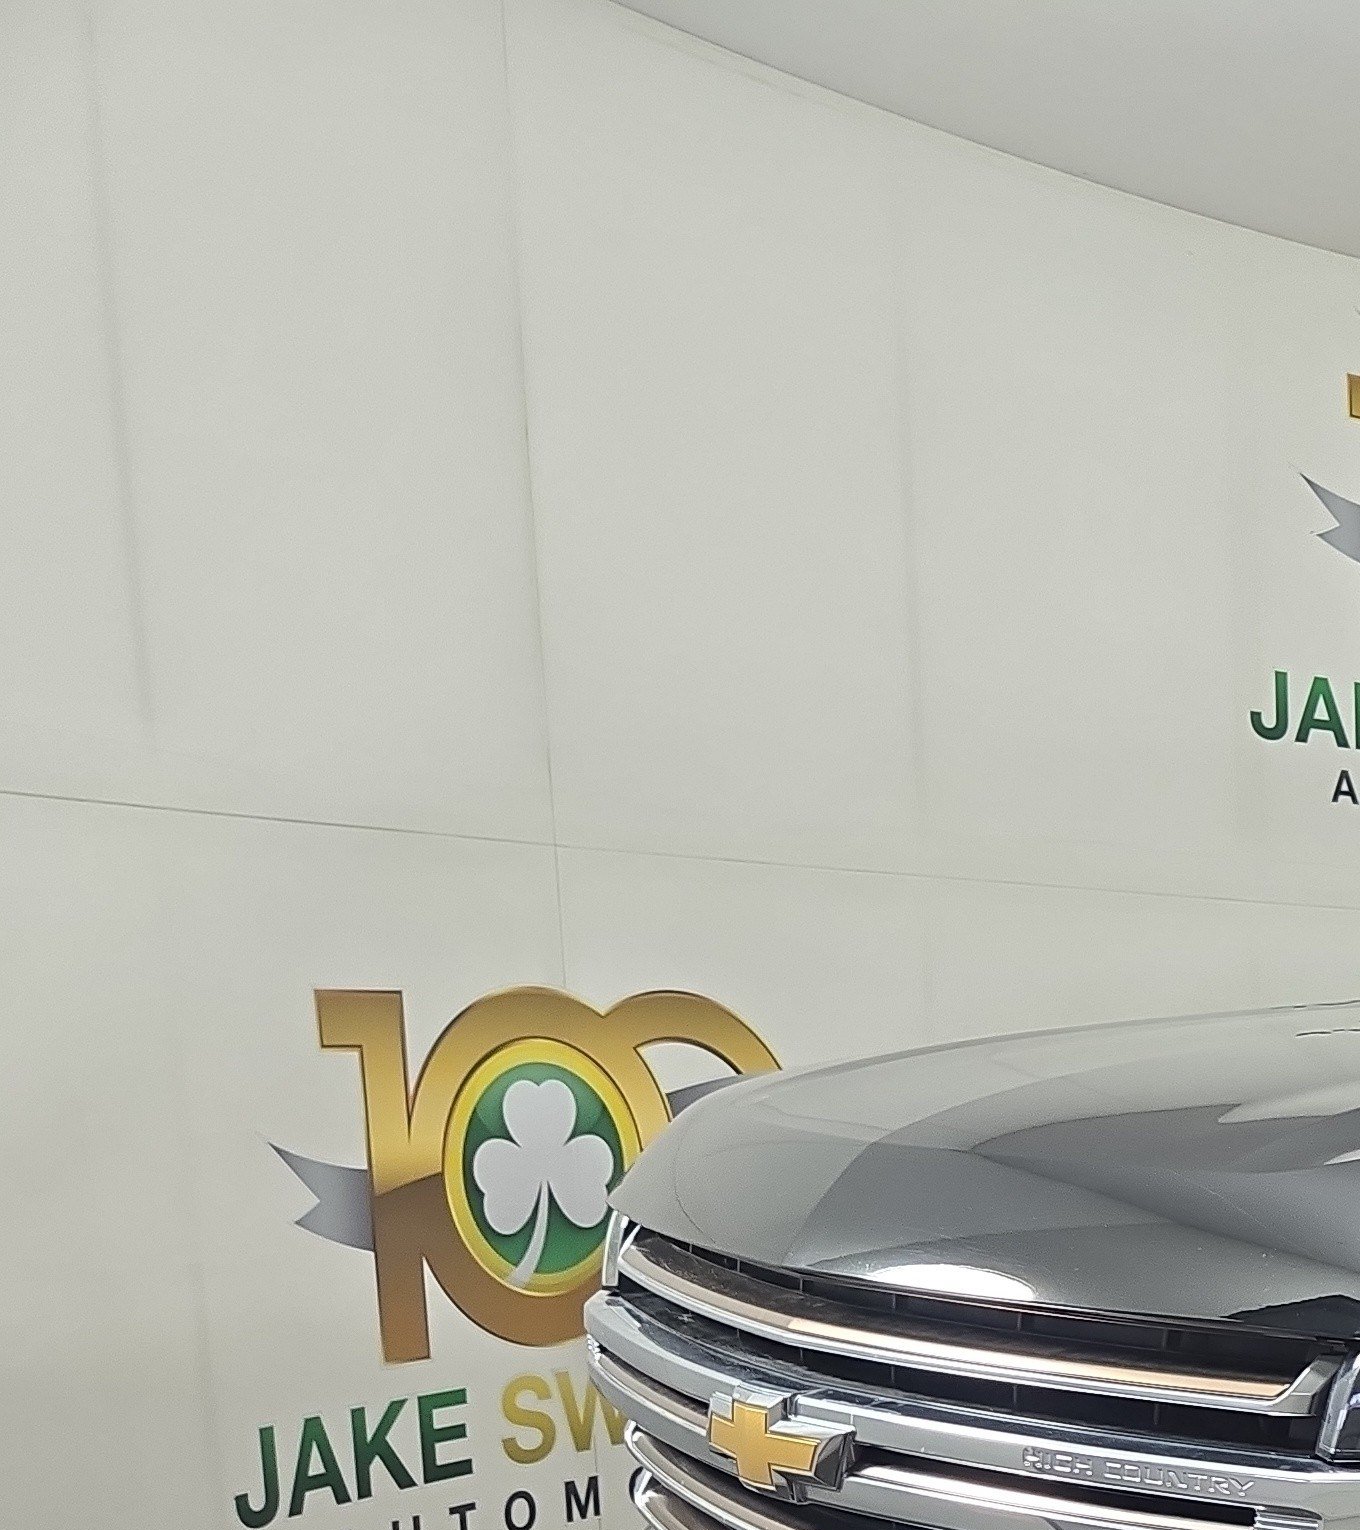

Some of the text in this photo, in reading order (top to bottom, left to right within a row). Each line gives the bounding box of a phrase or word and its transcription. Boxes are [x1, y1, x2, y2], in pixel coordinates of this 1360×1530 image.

[234, 1387, 473, 1529] JAKE
[1022, 1446, 1255, 1497] HIGH COUNTRY
